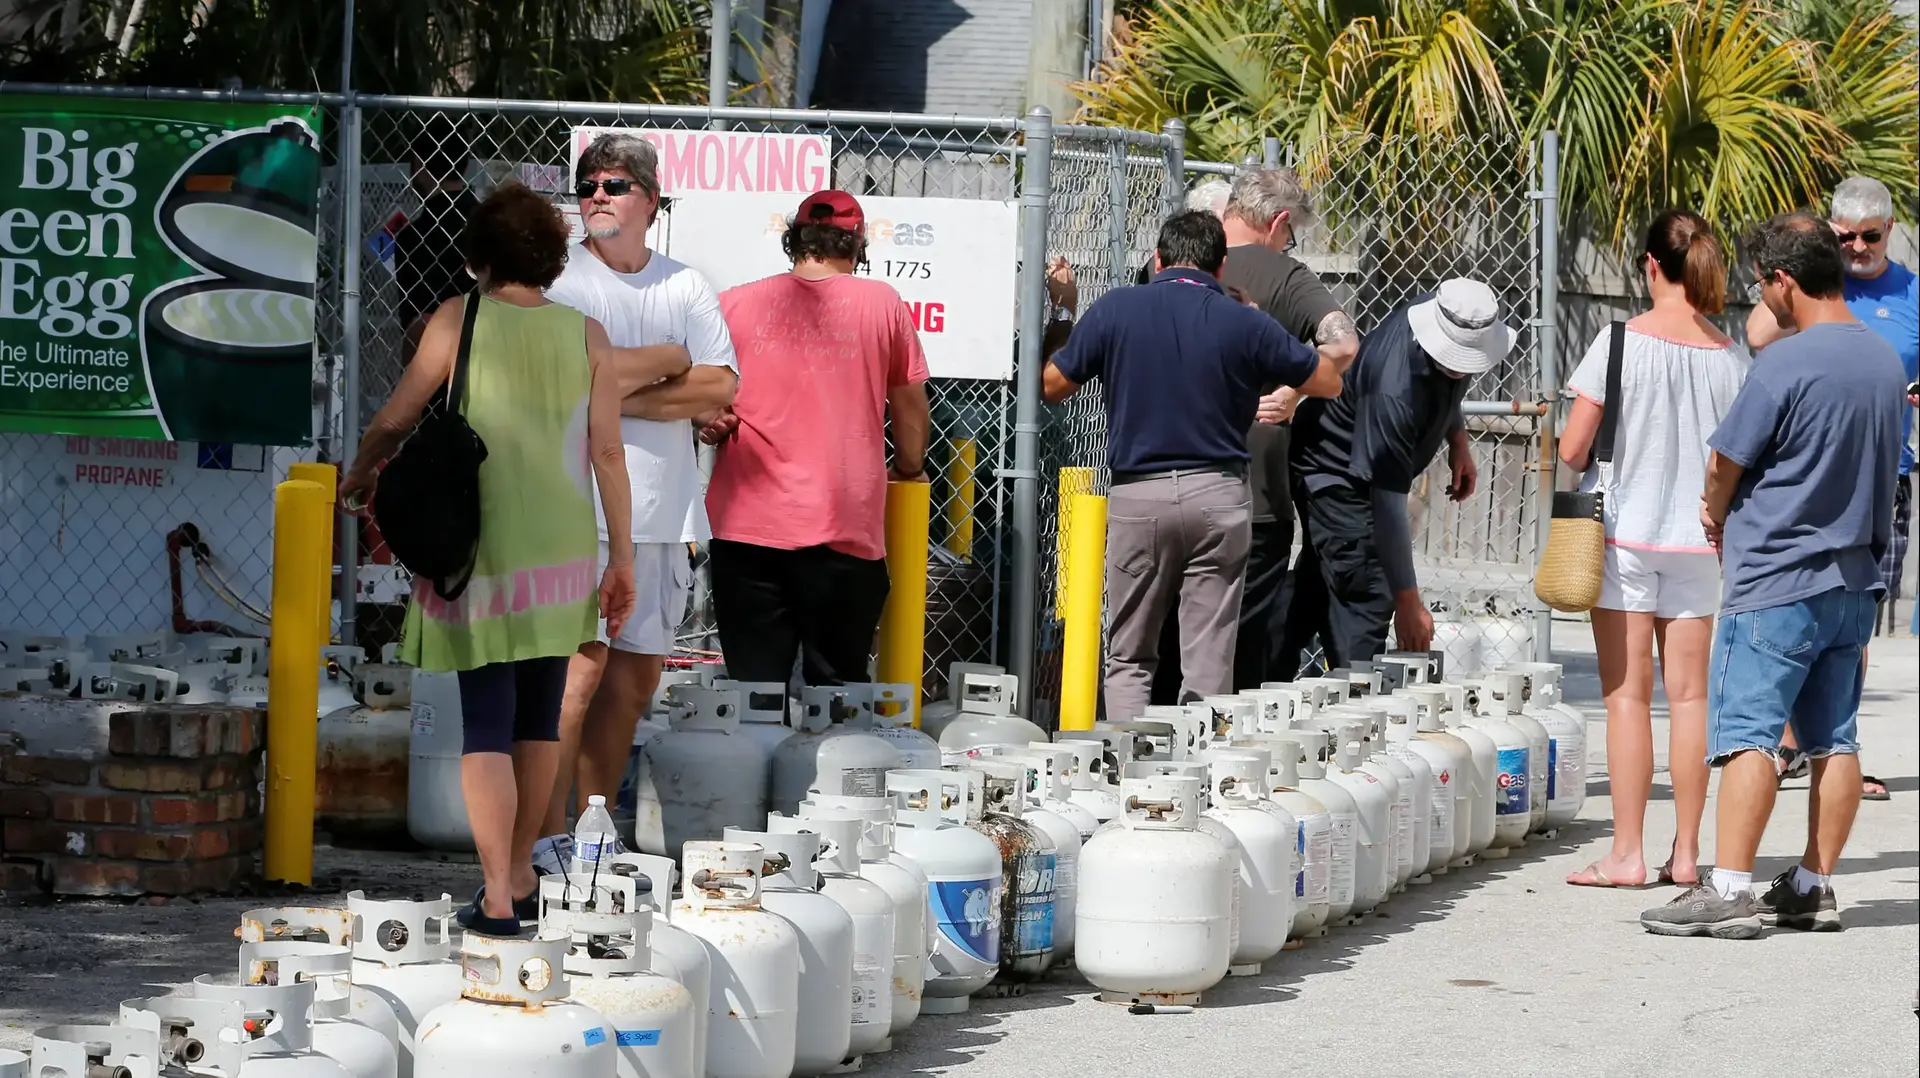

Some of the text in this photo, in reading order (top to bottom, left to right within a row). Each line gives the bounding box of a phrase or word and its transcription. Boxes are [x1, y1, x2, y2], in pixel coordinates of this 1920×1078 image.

[19, 127, 139, 208] Big
[0, 207, 136, 259] een
[884, 260, 932, 279] 1775
[0, 258, 135, 339] Egg
[0, 341, 129, 368] he Ultimate
[1, 366, 129, 392] Experience
[66, 436, 178, 461] NO SMOKING
[75, 464, 164, 487] PROPANE
